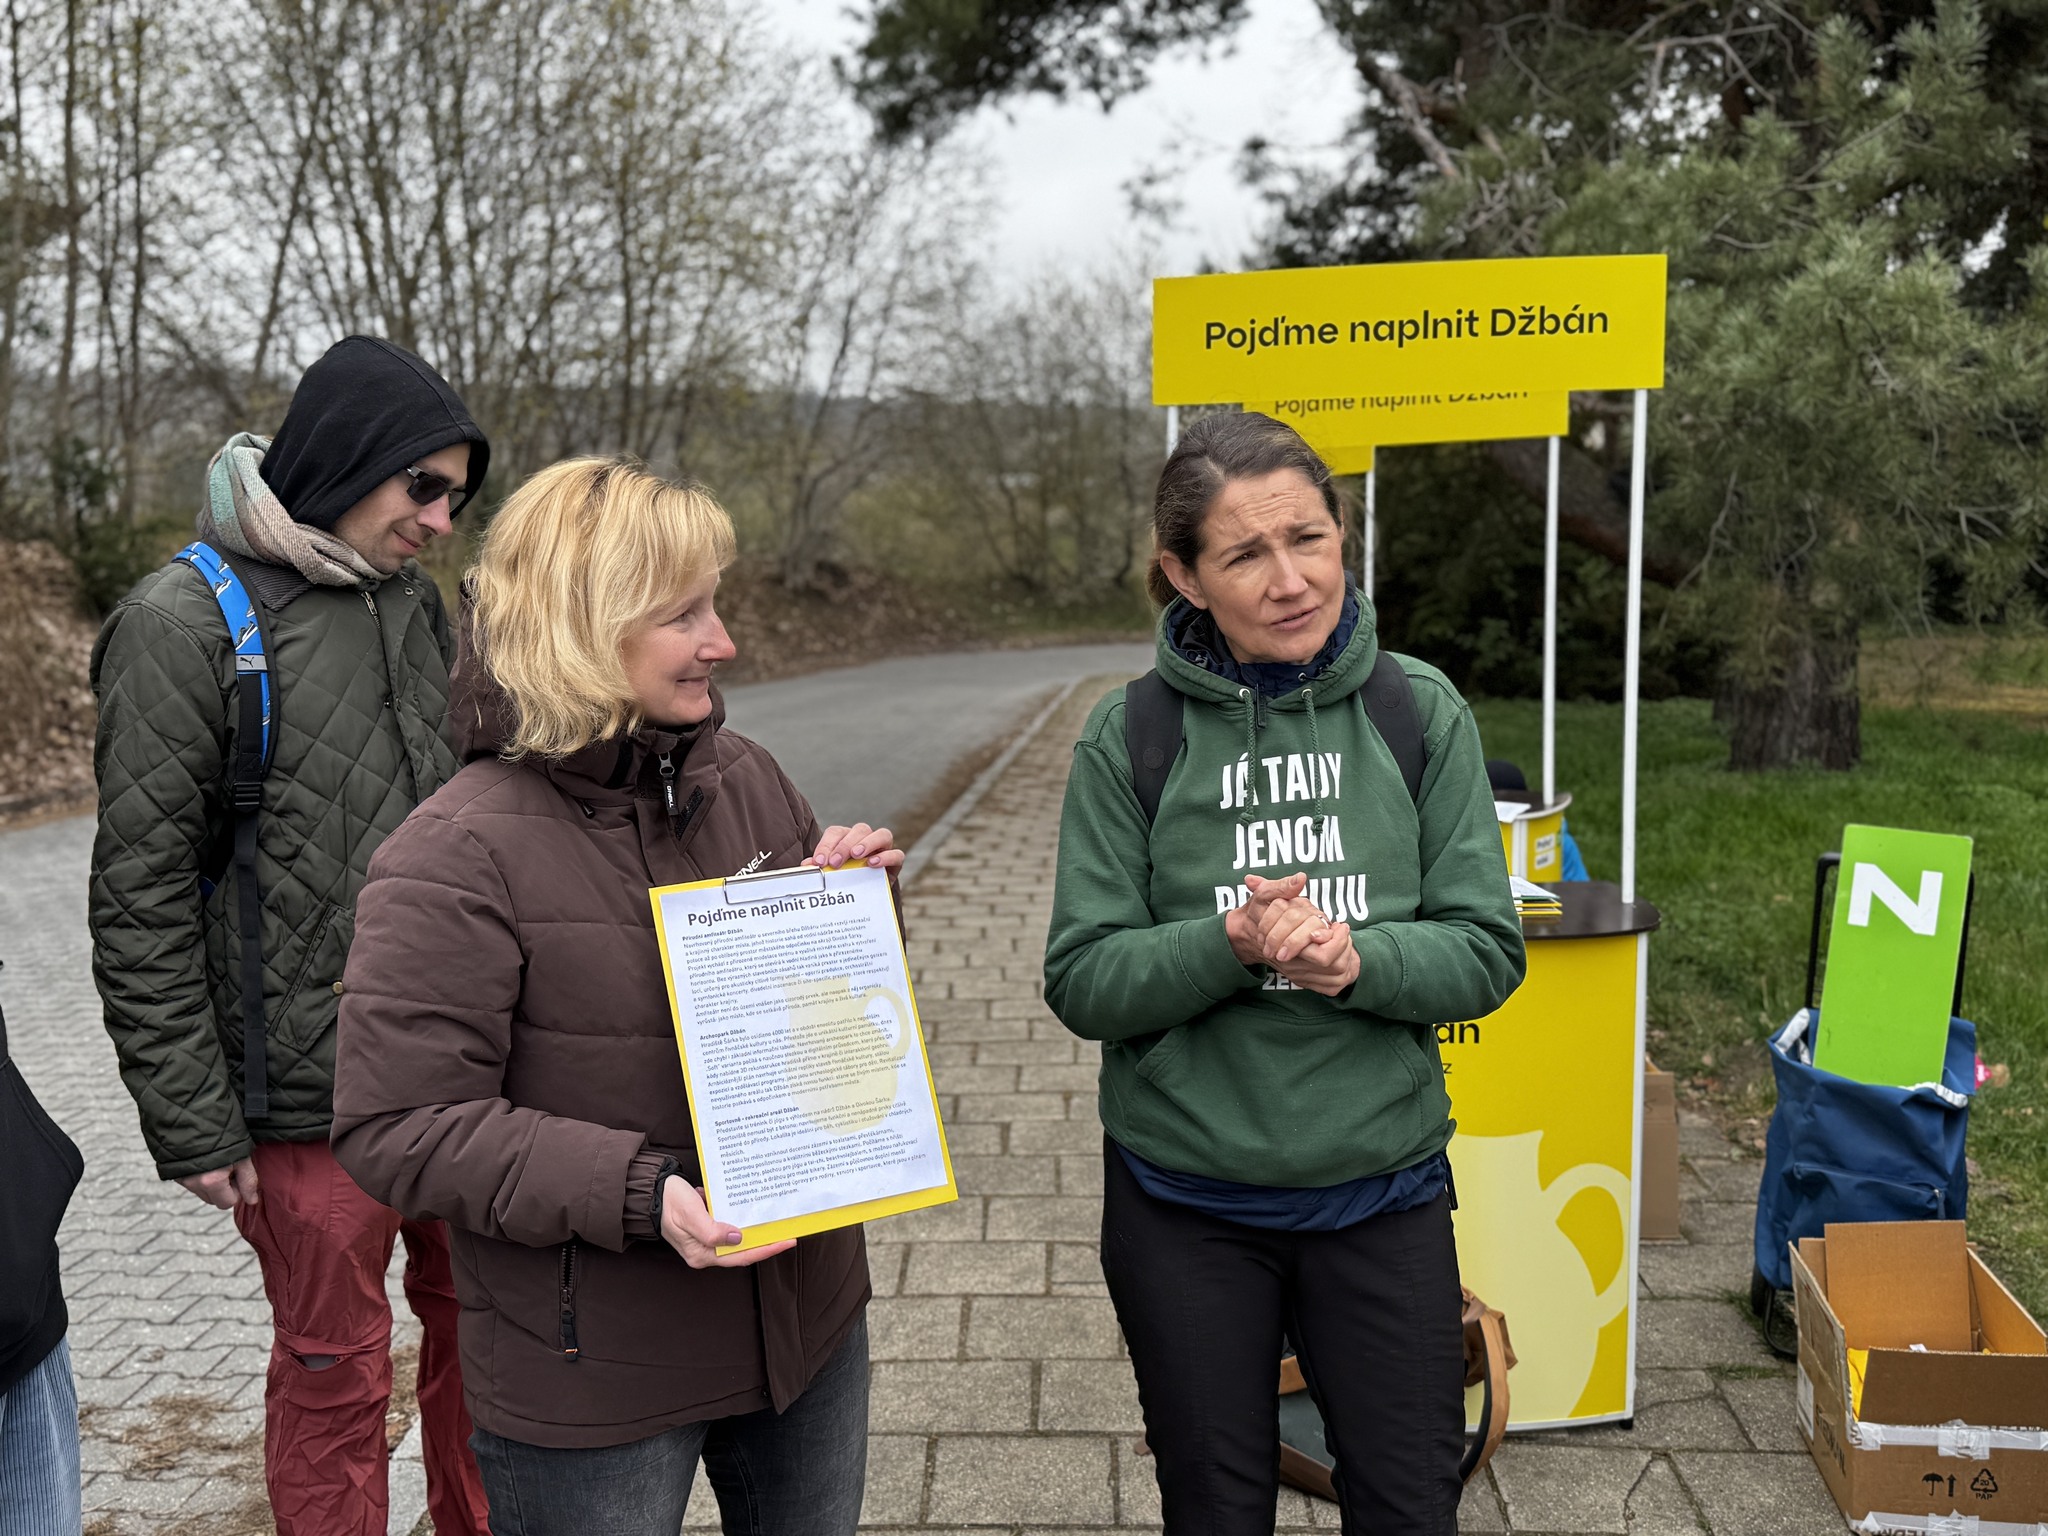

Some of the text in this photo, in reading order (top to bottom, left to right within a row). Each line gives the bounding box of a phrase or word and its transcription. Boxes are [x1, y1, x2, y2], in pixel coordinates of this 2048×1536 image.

[1205, 304, 1608, 355] Pojďme naplnit Džbán
[1220, 752, 1341, 809] JÁ TADY
[1233, 815, 1345, 870] JENOM
[688, 892, 856, 926] Pojďme naplnit Džbán
[1847, 862, 1943, 936] N
